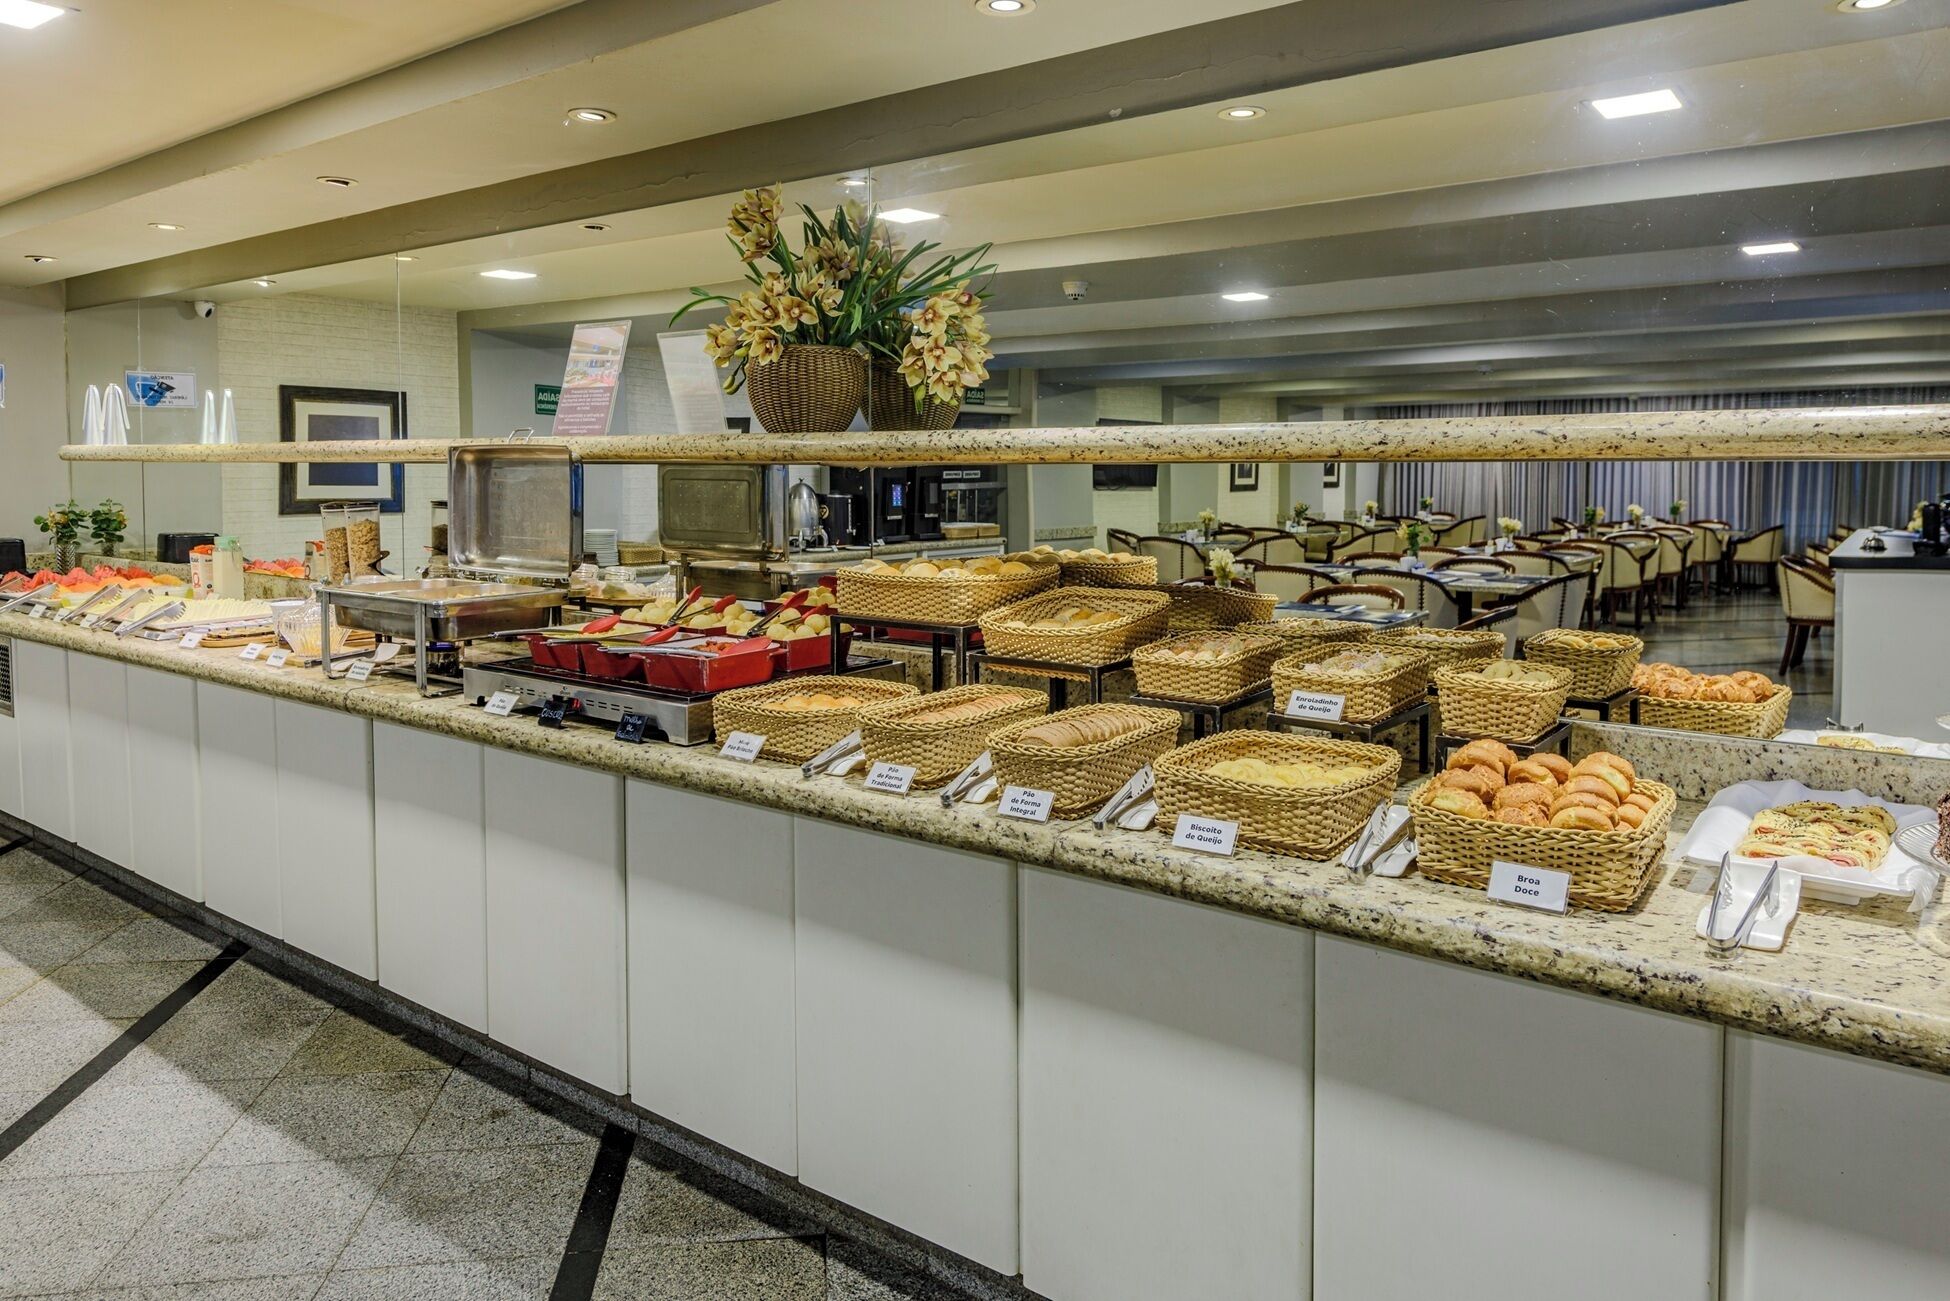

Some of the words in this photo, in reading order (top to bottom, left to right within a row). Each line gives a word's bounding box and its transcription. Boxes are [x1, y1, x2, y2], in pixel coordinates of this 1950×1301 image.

[1295, 695, 1338, 706] Enroladinho
[1308, 705, 1331, 713] Queijo
[884, 774, 903, 782] Forma
[871, 779, 903, 789] Tradicional
[1022, 790, 1035, 798] Pão
[1020, 799, 1041, 808] Forma
[1009, 805, 1037, 816] Integral
[1190, 823, 1222, 835] Biscoito
[1185, 832, 1195, 840] de
[1197, 834, 1223, 845] Queijo
[1517, 874, 1541, 886] Broa
[1514, 885, 1540, 897] Doce
